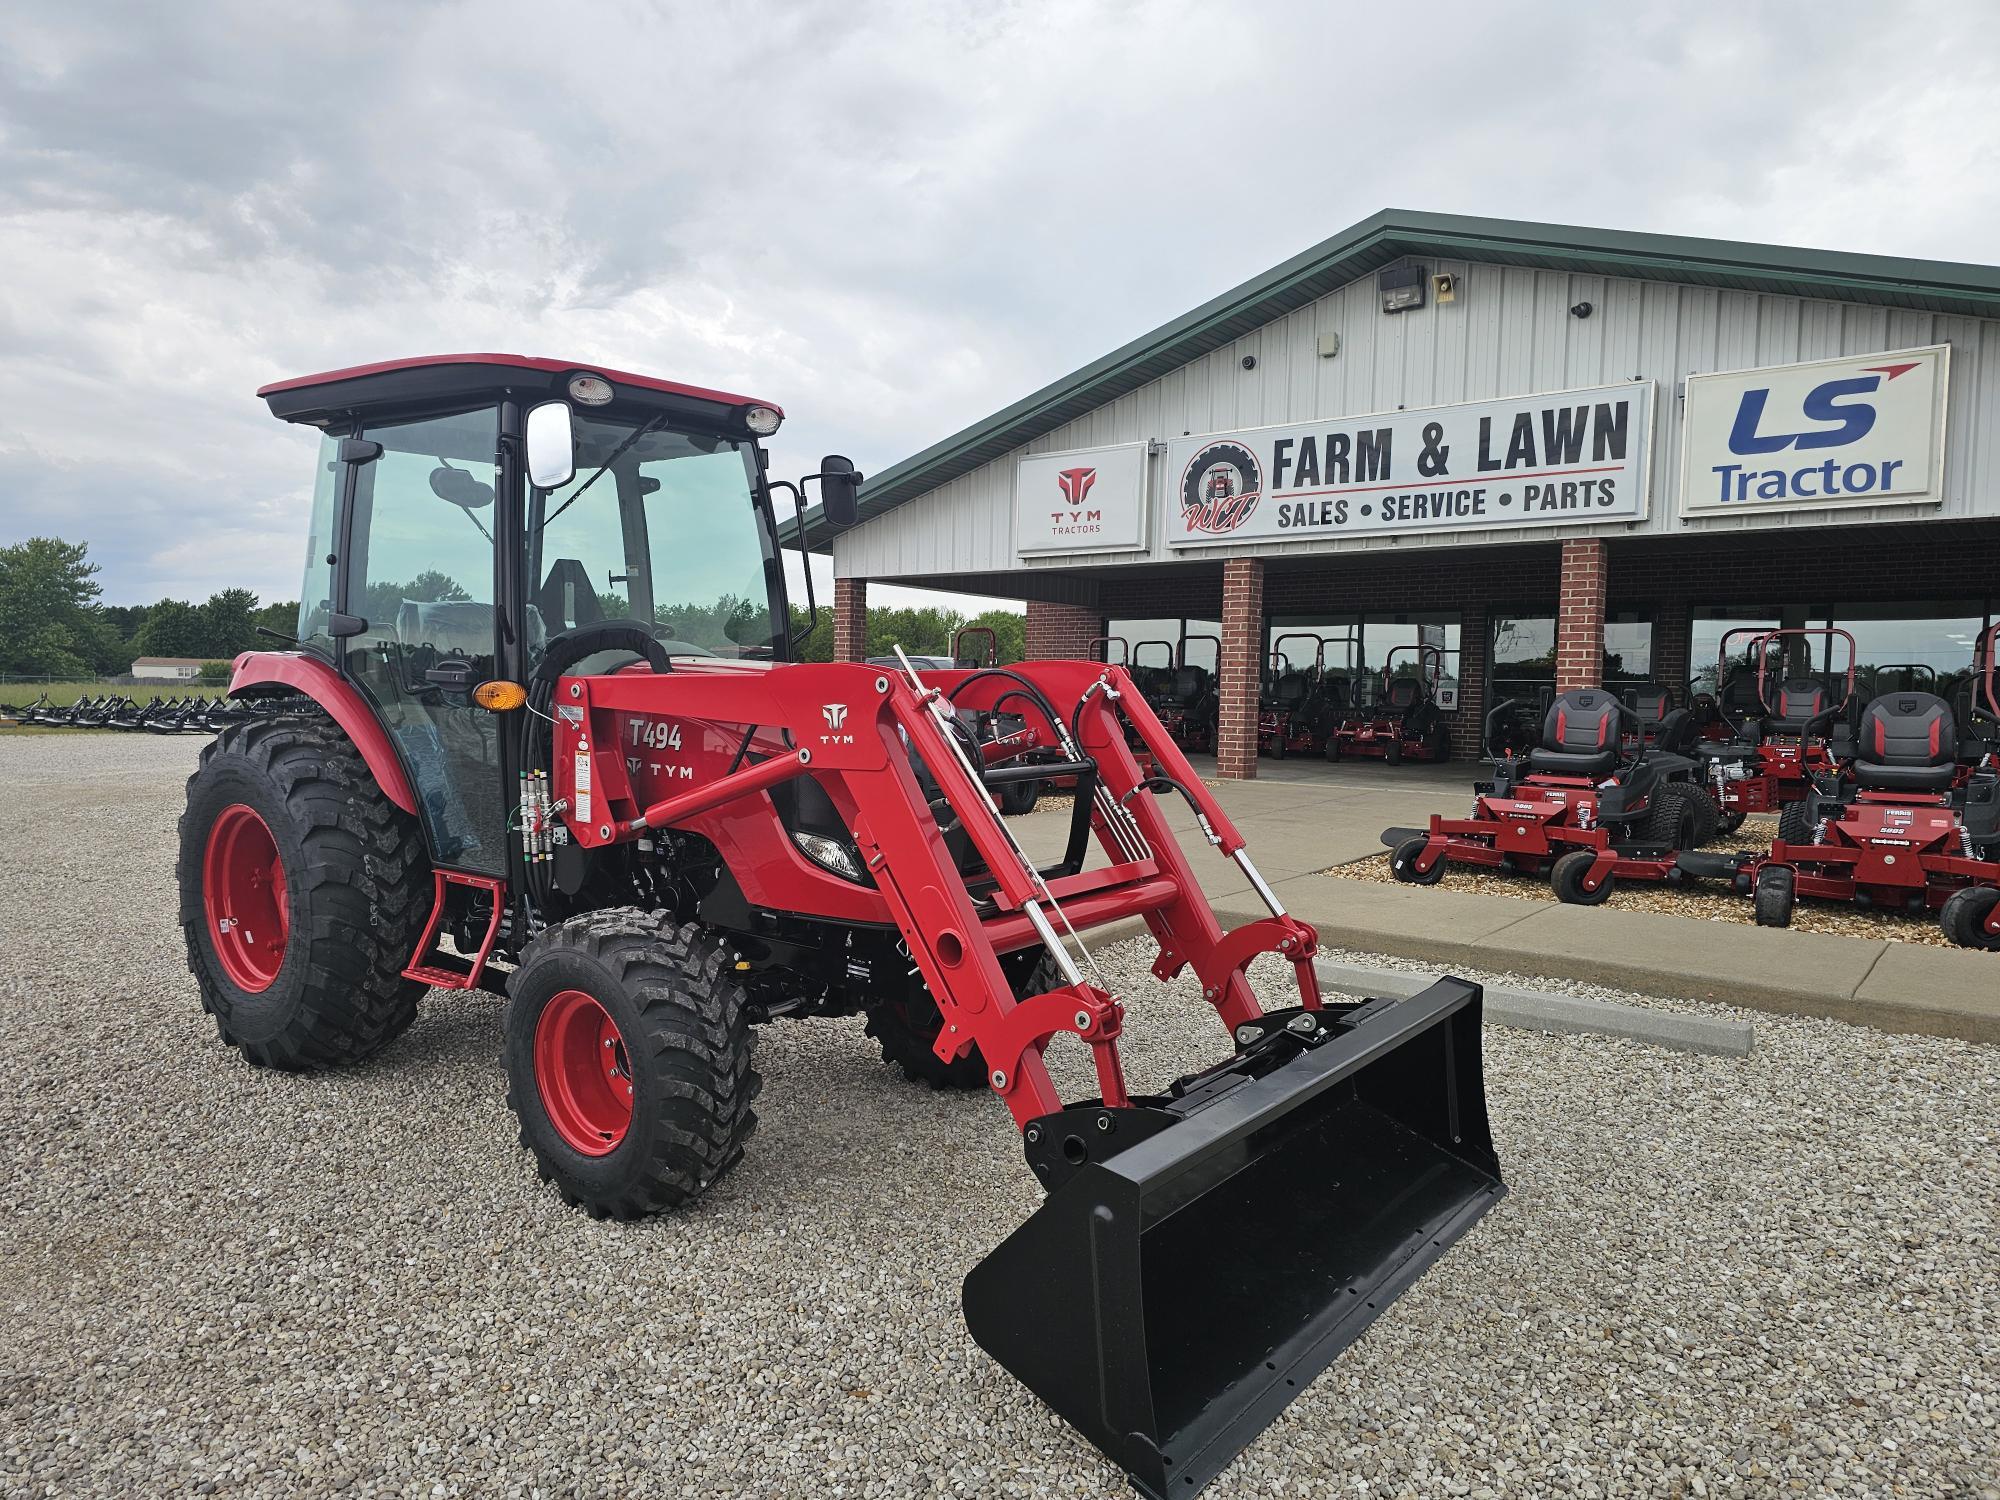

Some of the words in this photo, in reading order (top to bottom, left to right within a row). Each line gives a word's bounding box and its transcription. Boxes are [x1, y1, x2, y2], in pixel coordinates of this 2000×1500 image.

[1729, 376, 1881, 455] LS
[1272, 428, 1393, 489] FARM
[1417, 421, 1450, 478] &
[1478, 400, 1629, 472] LAWN
[1712, 458, 1903, 502] Tractor
[1051, 510, 1101, 523] TYM
[1181, 492, 1261, 532] WCT
[1277, 500, 1349, 528] SALES
[1381, 489, 1486, 521] SERVICE
[1524, 478, 1615, 511] PARTS
[1052, 525, 1101, 535] TRACTORS
[629, 719, 682, 751] T494
[820, 735, 854, 744] TYM
[650, 763, 693, 779] TYM
